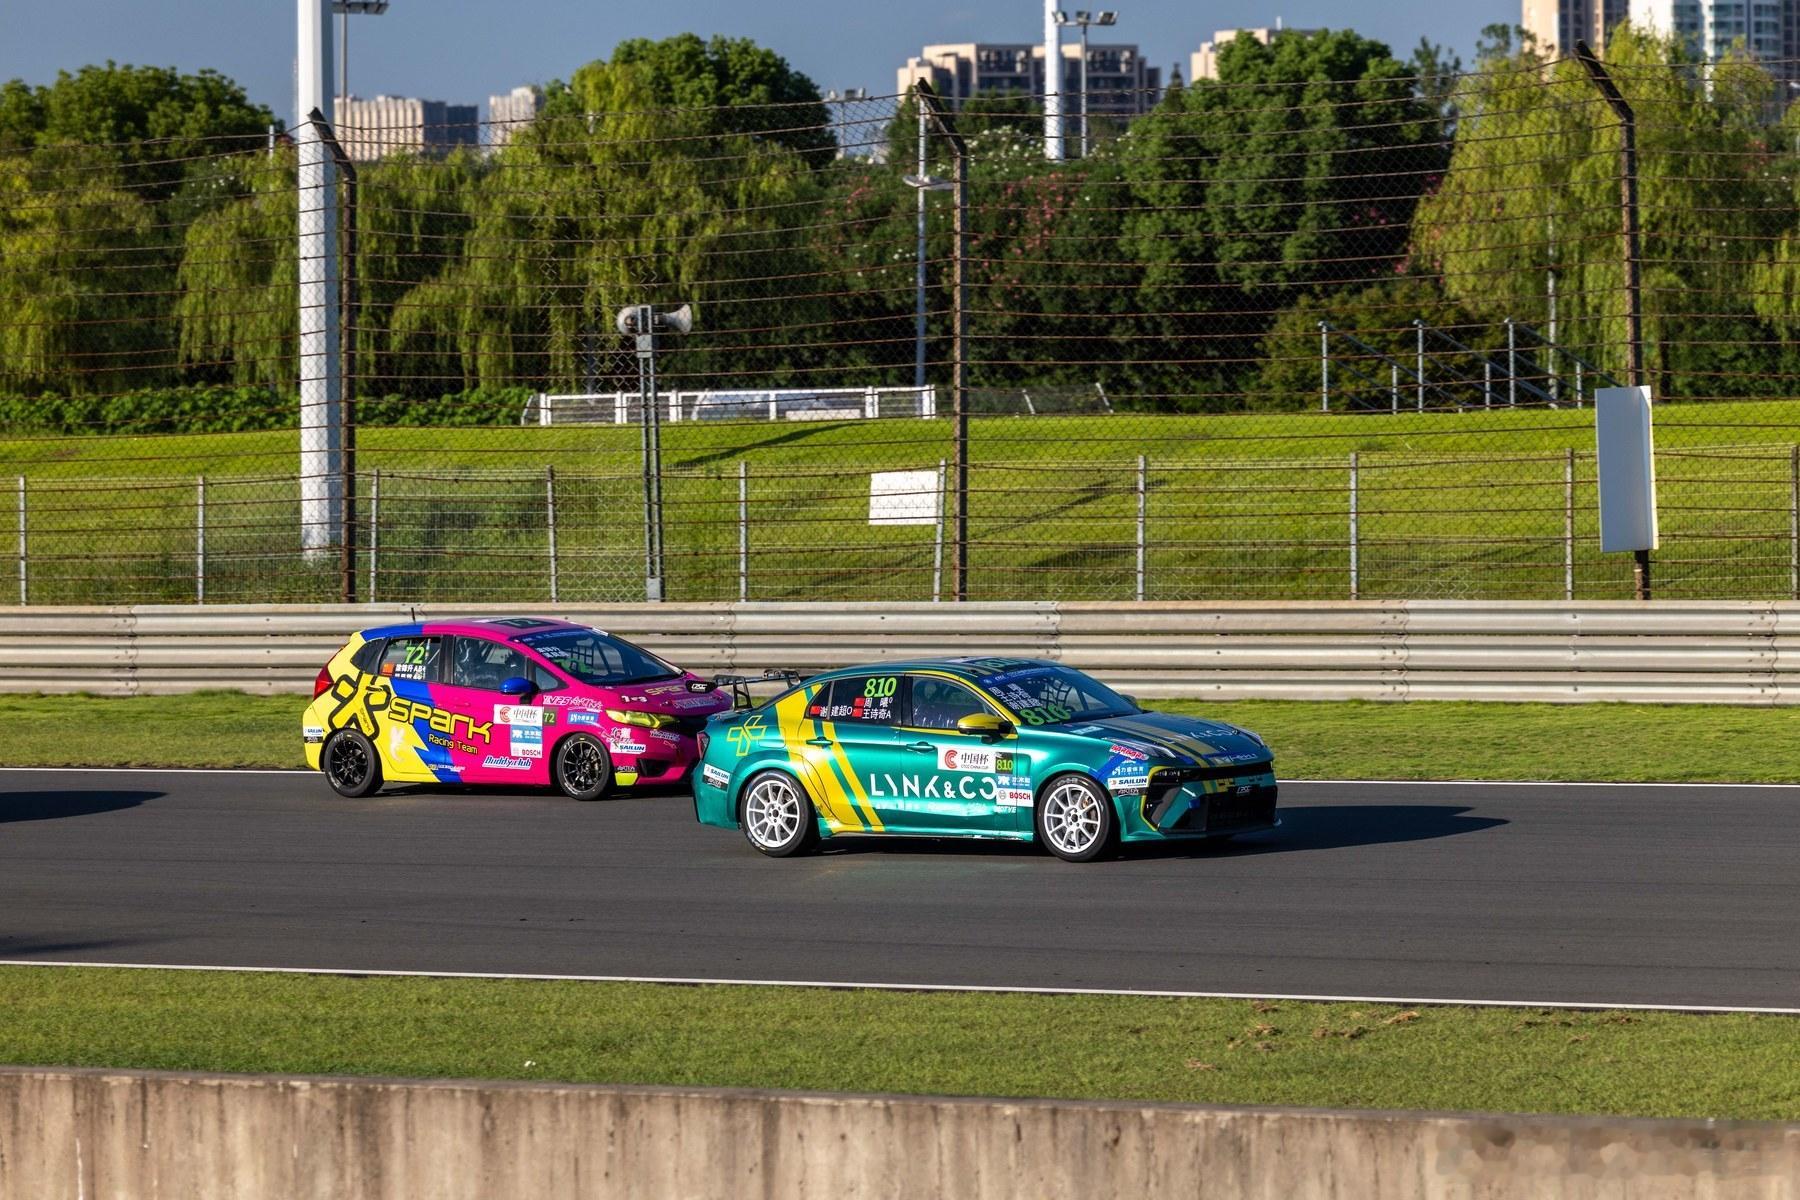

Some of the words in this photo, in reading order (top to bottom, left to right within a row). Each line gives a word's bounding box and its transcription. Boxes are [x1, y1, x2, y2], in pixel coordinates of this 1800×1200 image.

[405, 646, 426, 665] 72
[864, 677, 897, 698] 810
[543, 712, 555, 723] 72
[428, 733, 455, 750] Racing
[457, 740, 478, 755] Team
[960, 752, 989, 765] 中国杯
[997, 759, 1013, 771] 810
[1118, 777, 1148, 785] SAILUN
[1009, 791, 1031, 801] BOSCH
